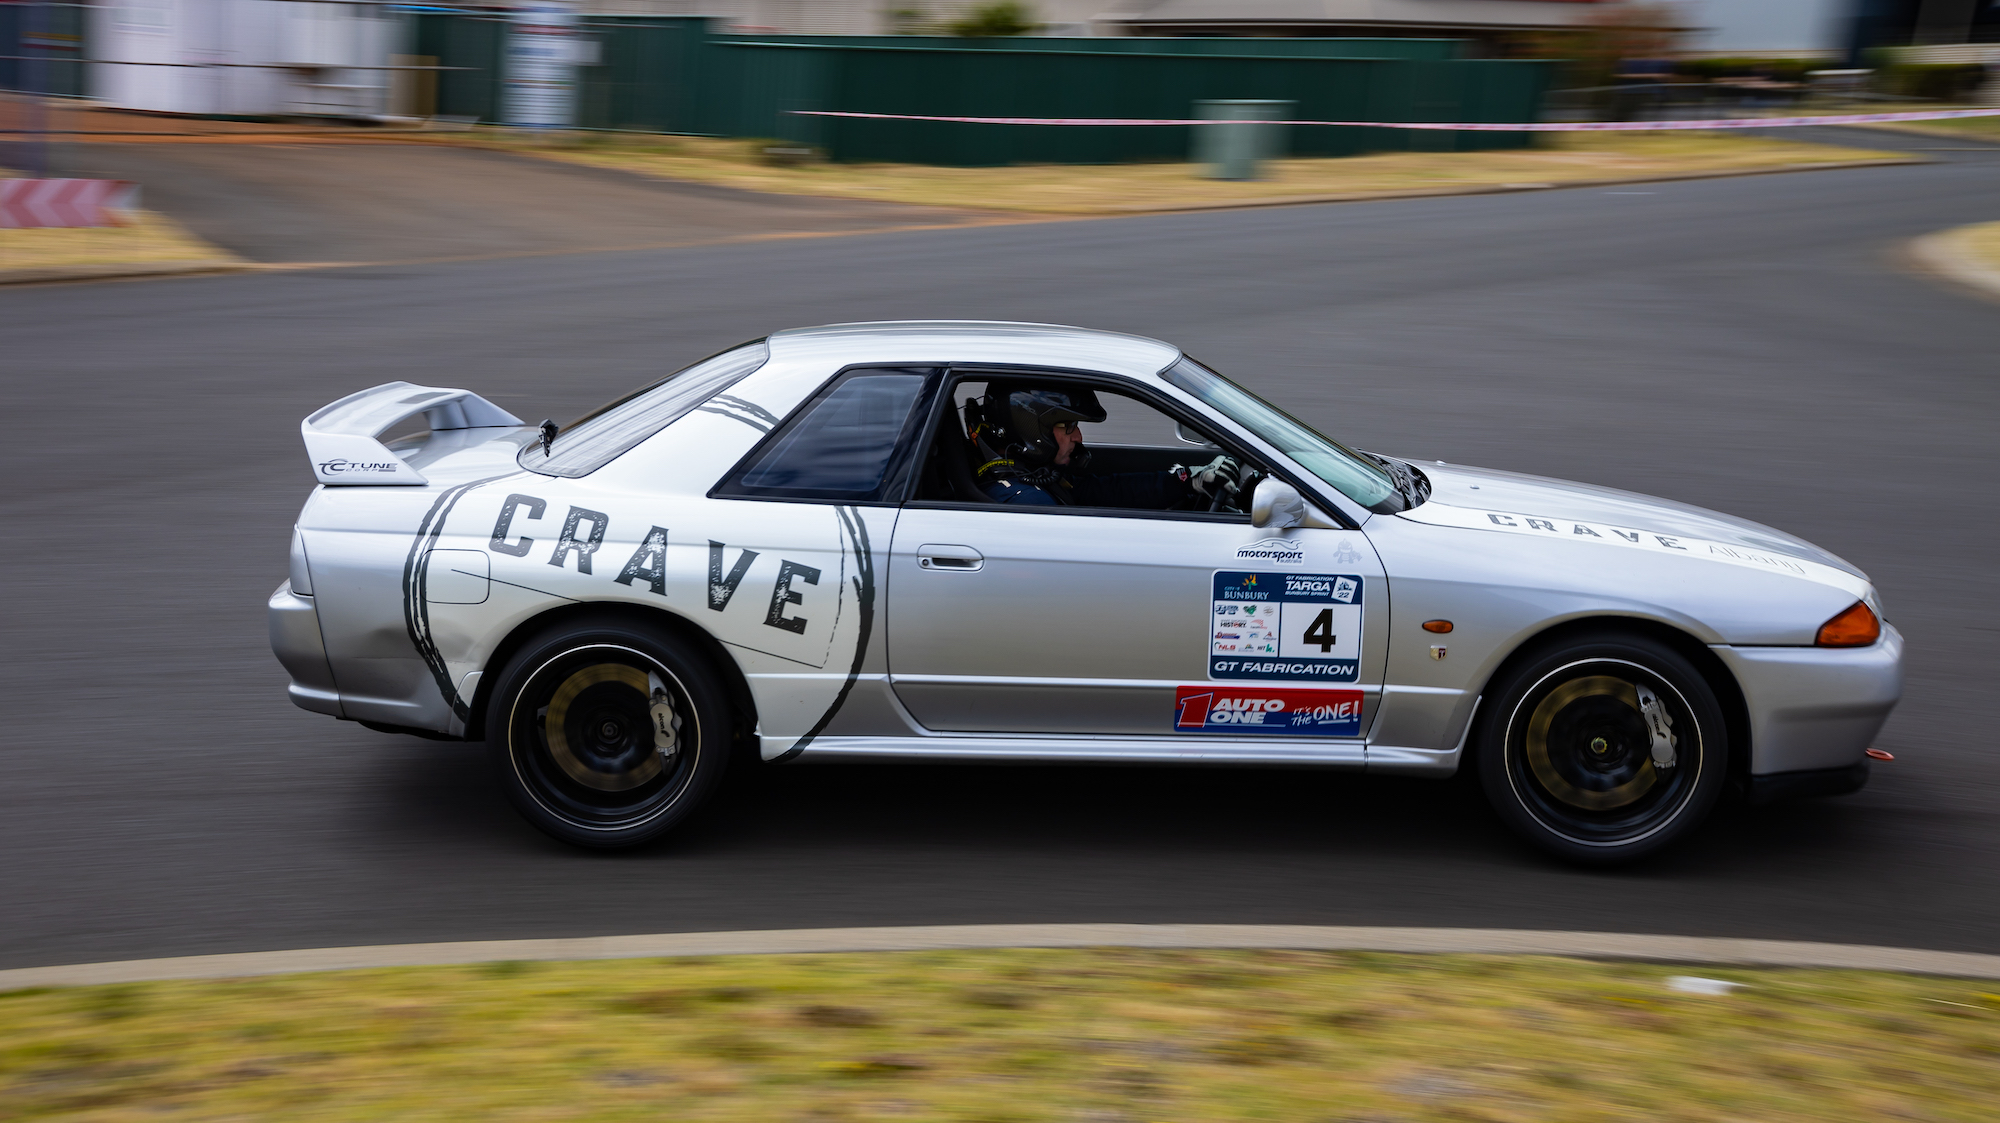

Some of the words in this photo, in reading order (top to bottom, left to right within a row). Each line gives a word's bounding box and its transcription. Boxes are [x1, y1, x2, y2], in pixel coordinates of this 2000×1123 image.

[1486, 513, 1688, 550] CRAVE
[488, 493, 822, 635] CRAVE
[1237, 550, 1304, 563] motorsport
[1708, 544, 1806, 575] Albany
[1224, 590, 1270, 600] BUNBURY
[1285, 580, 1331, 592] TARGA
[1303, 608, 1337, 653] 4
[1214, 661, 1240, 672] GT
[1241, 662, 1355, 676] FABRICATION
[1177, 691, 1215, 729] 1
[1212, 698, 1286, 713] AUTO
[1210, 711, 1267, 725] ONE
[1313, 700, 1360, 723] ONE!
[1291, 715, 1312, 727] THE
